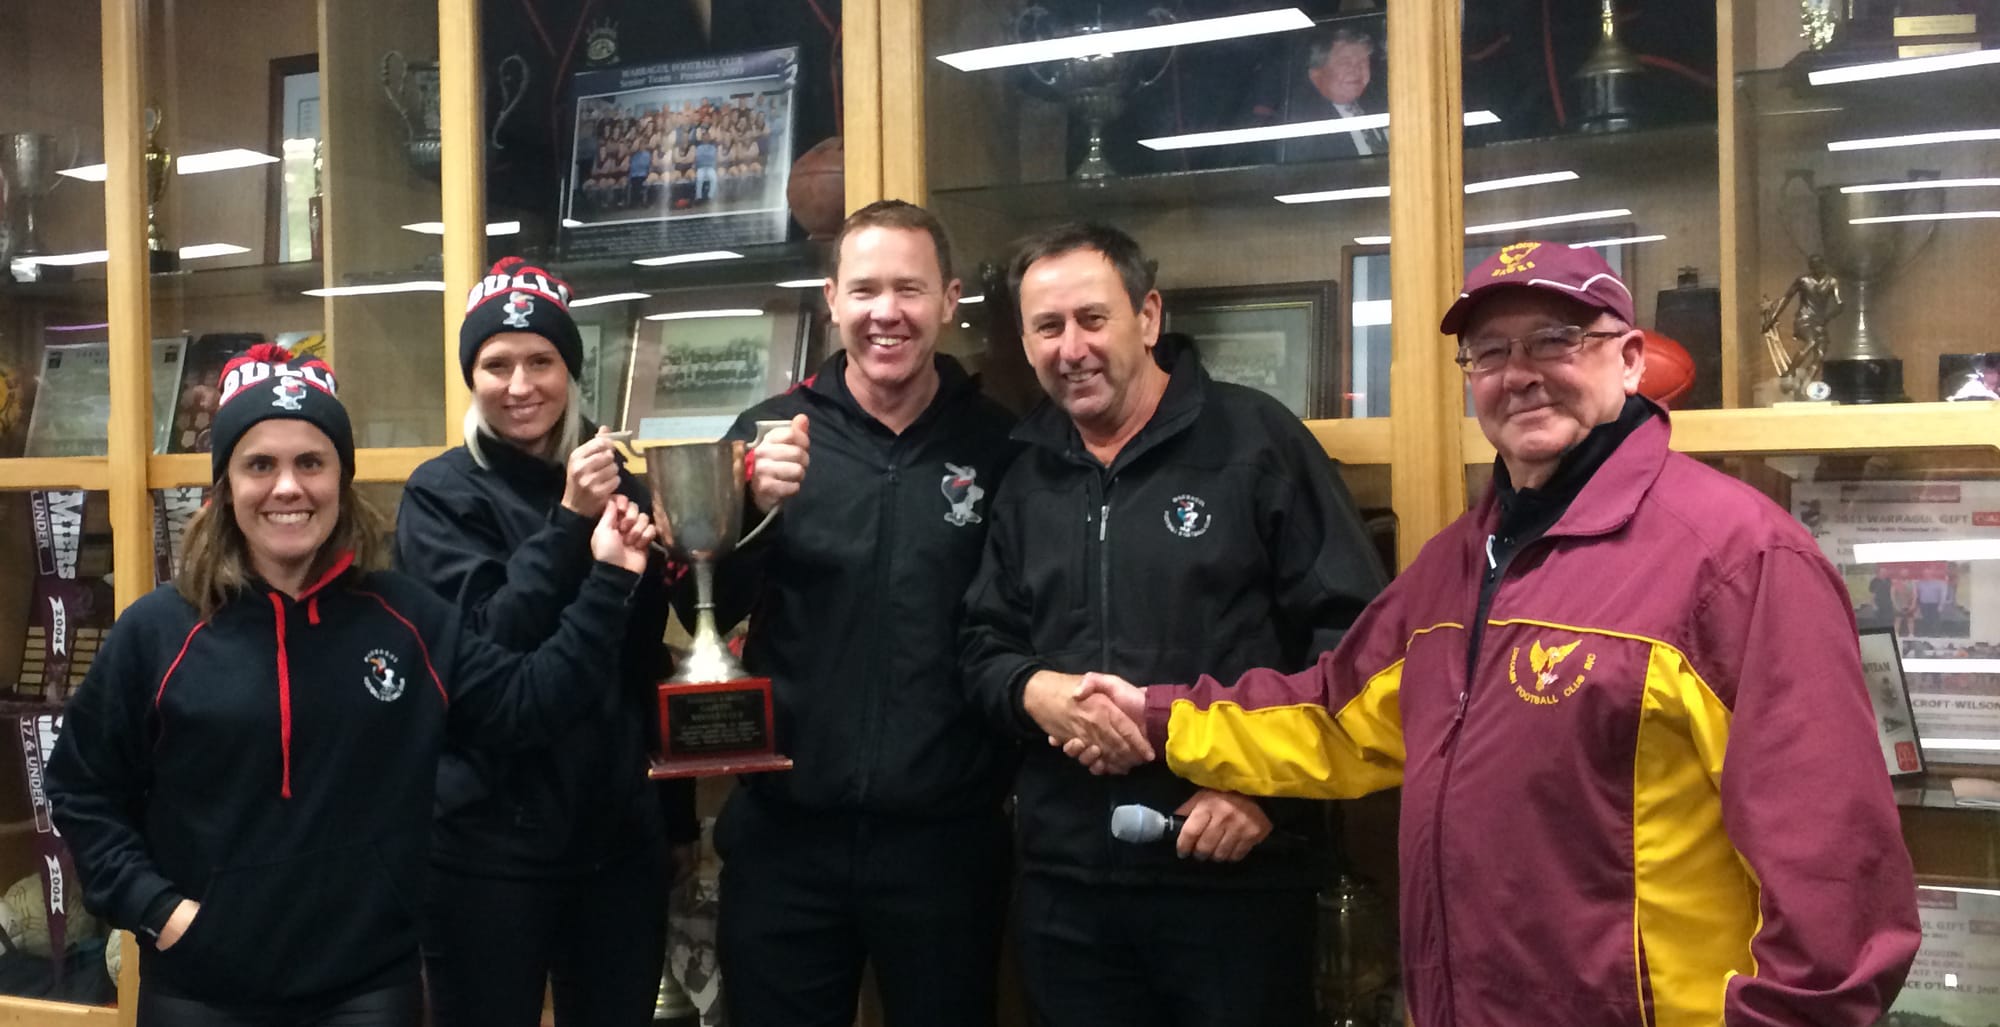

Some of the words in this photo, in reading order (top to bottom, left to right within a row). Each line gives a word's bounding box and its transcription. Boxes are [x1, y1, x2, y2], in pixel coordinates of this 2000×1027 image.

[33, 499, 49, 549] UNDER
[1939, 513, 1968, 524] GIFT
[54, 609, 63, 643] 2004
[1515, 684, 1560, 705] FOOTBALL
[22, 719, 33, 737] 17
[25, 740, 35, 752] &
[28, 756, 44, 806] UNDER
[51, 867, 61, 905] 2004
